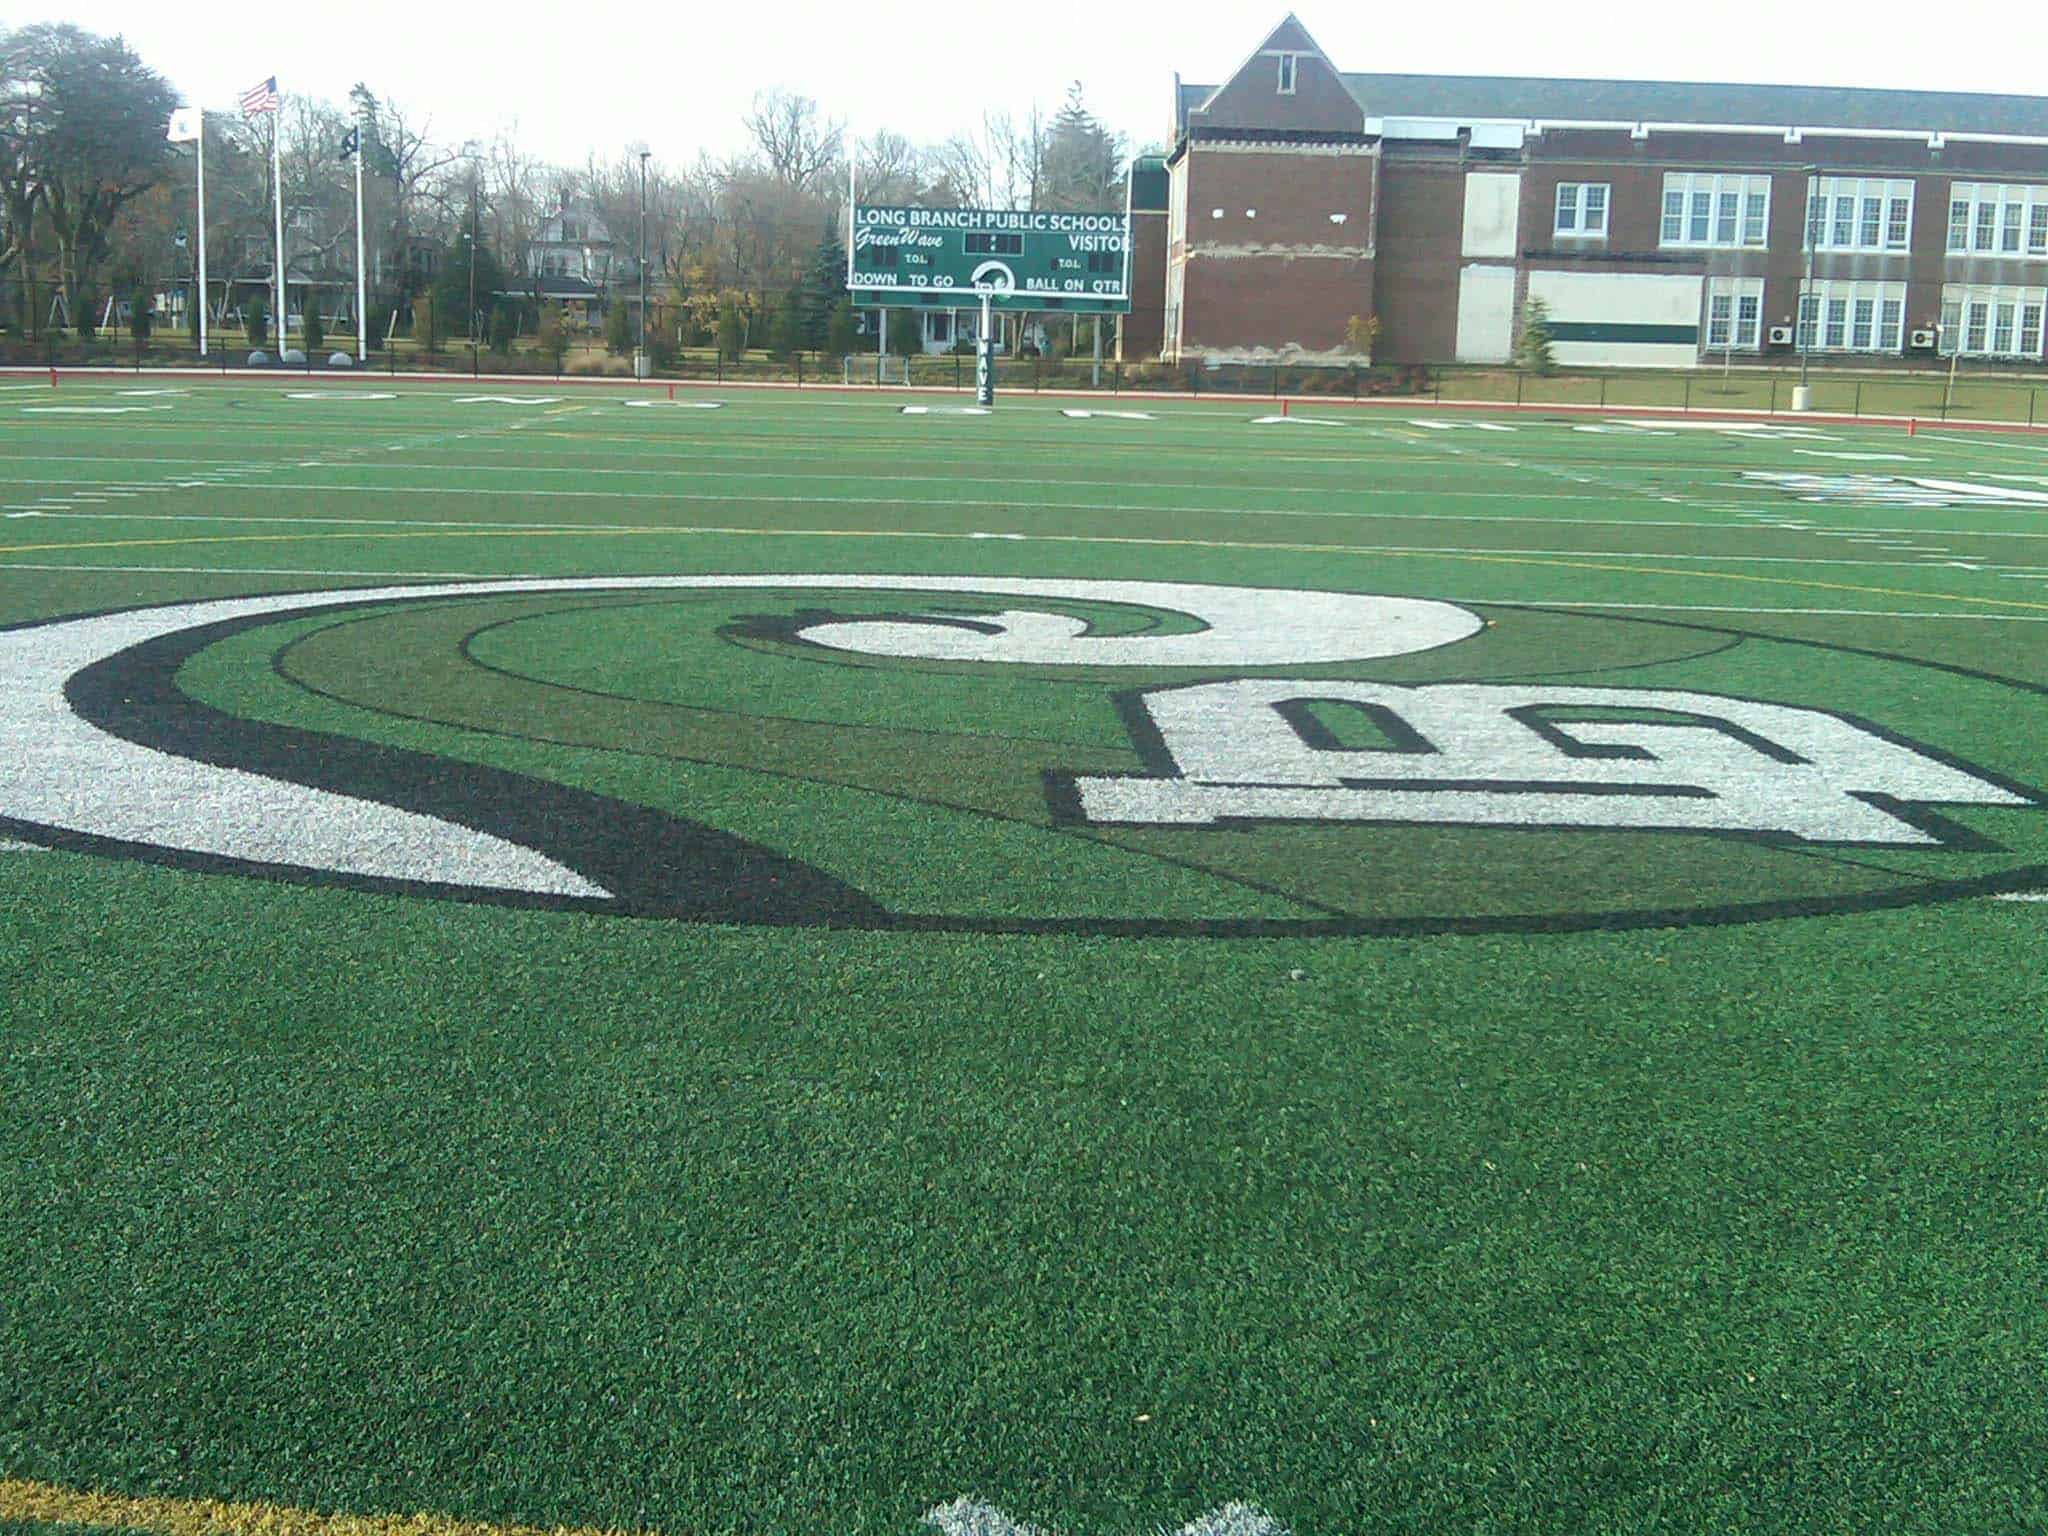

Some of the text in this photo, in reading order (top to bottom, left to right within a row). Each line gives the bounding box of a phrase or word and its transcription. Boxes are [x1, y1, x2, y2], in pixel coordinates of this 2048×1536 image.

[857, 209, 1130, 231] LONG BRANCH PUBLIC SCHOOLS
[854, 272, 897, 285] DOWN
[910, 274, 953, 287] TO GO
[1027, 278, 1083, 291] BALL ON
[1093, 280, 1120, 292] QTR
[978, 340, 989, 401] WAVE
